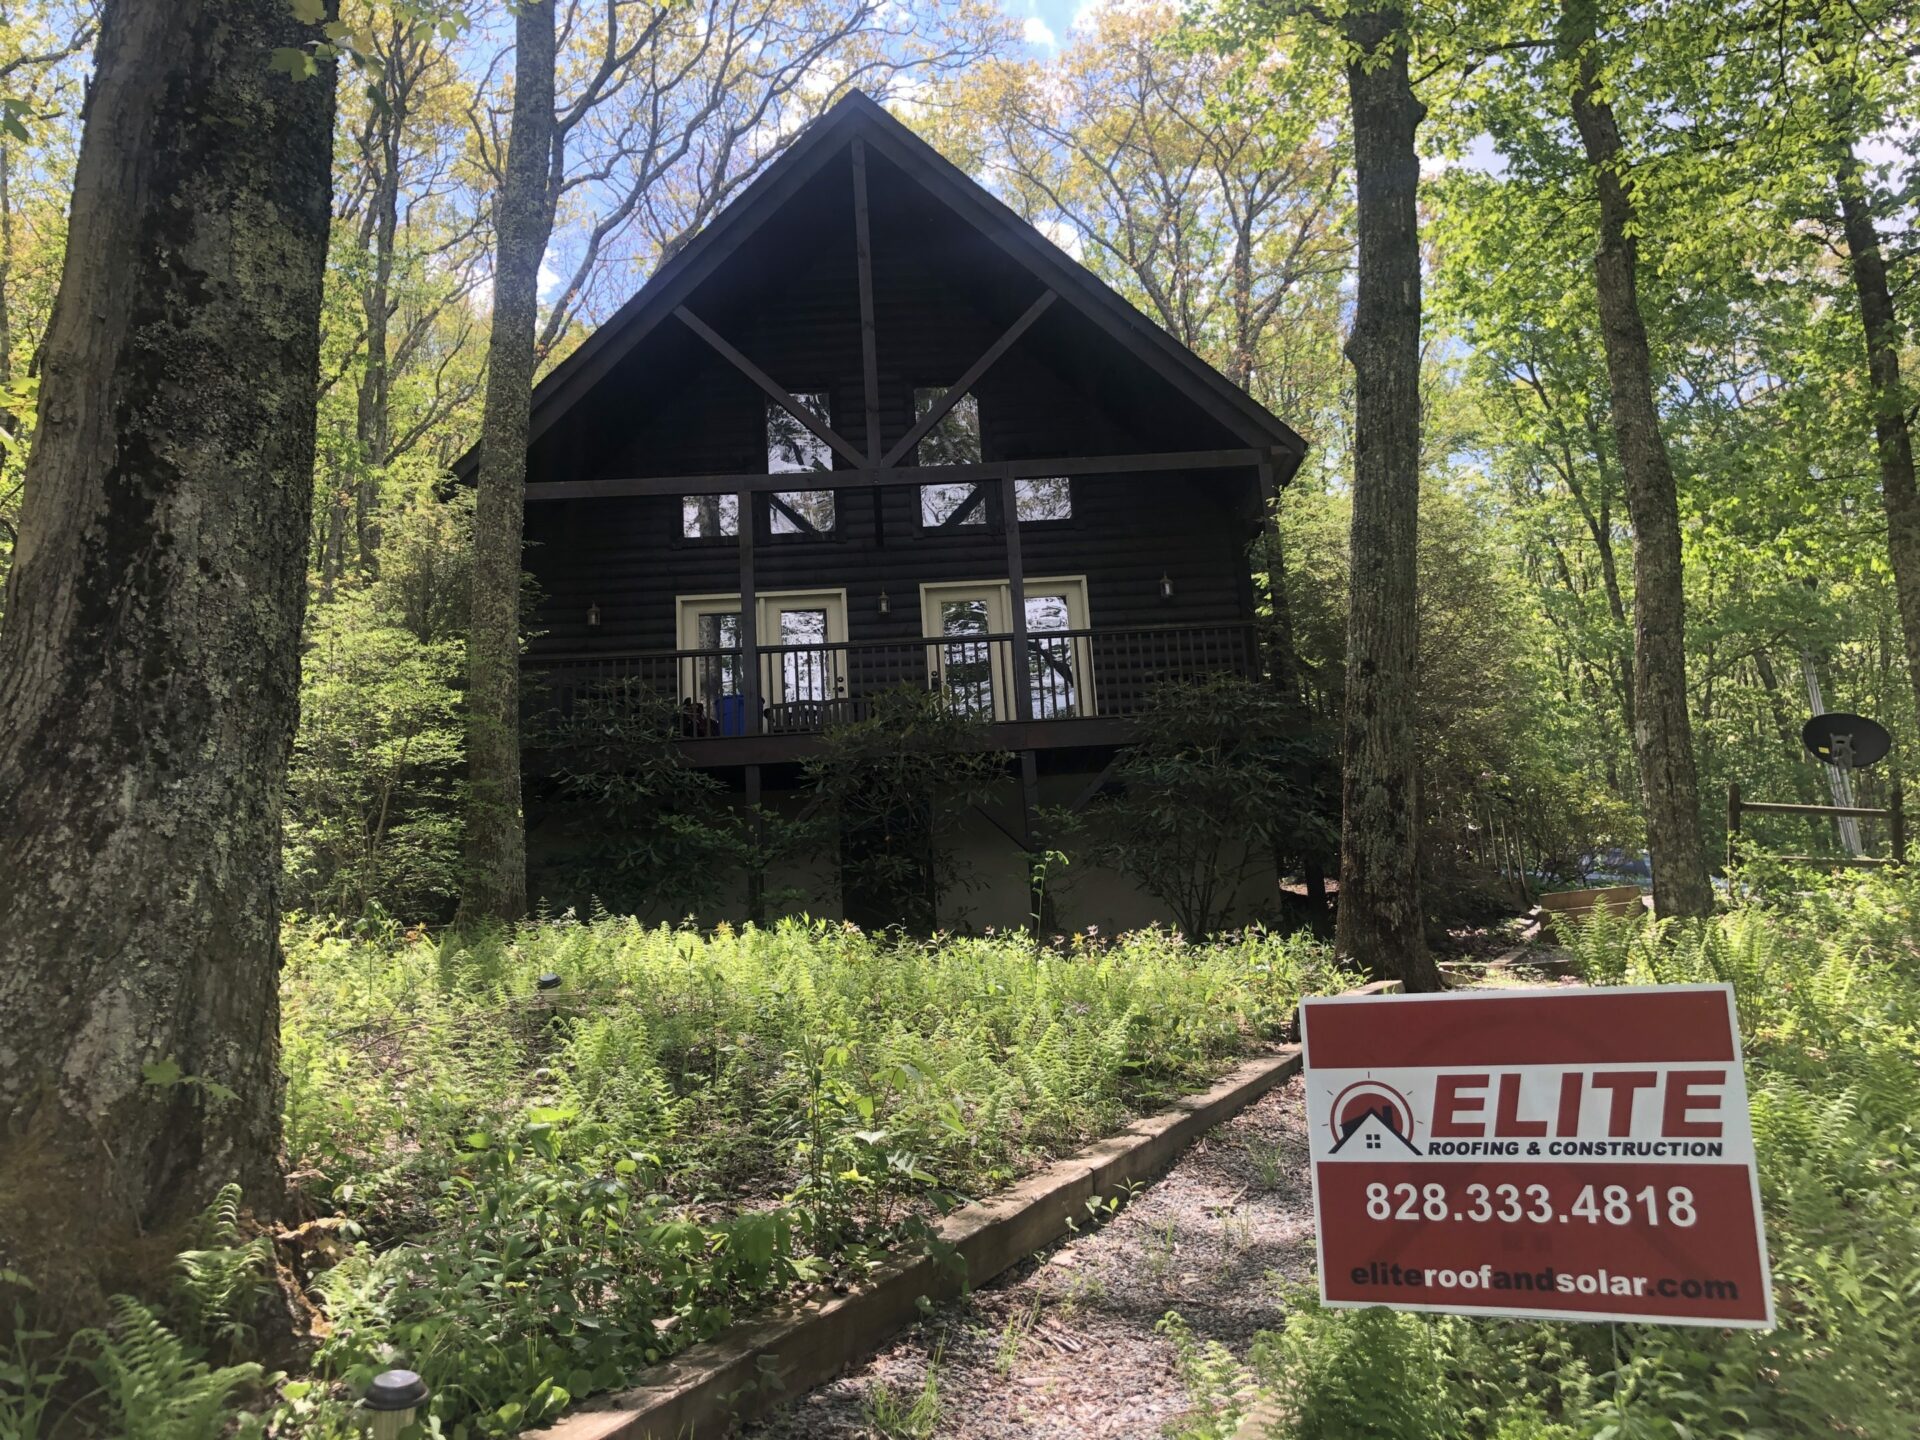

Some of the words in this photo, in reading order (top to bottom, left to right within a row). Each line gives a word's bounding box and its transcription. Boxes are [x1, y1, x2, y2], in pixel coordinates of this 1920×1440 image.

[1430, 1070, 1727, 1138] ELITE
[1428, 1141, 1519, 1156] ROOFING
[1527, 1141, 1541, 1156] &
[1549, 1141, 1723, 1157] CONSTRUCTION
[1366, 1182, 1697, 1227] 828.333.4818
[1350, 1262, 1739, 1300] eliteroofandsolar.com
